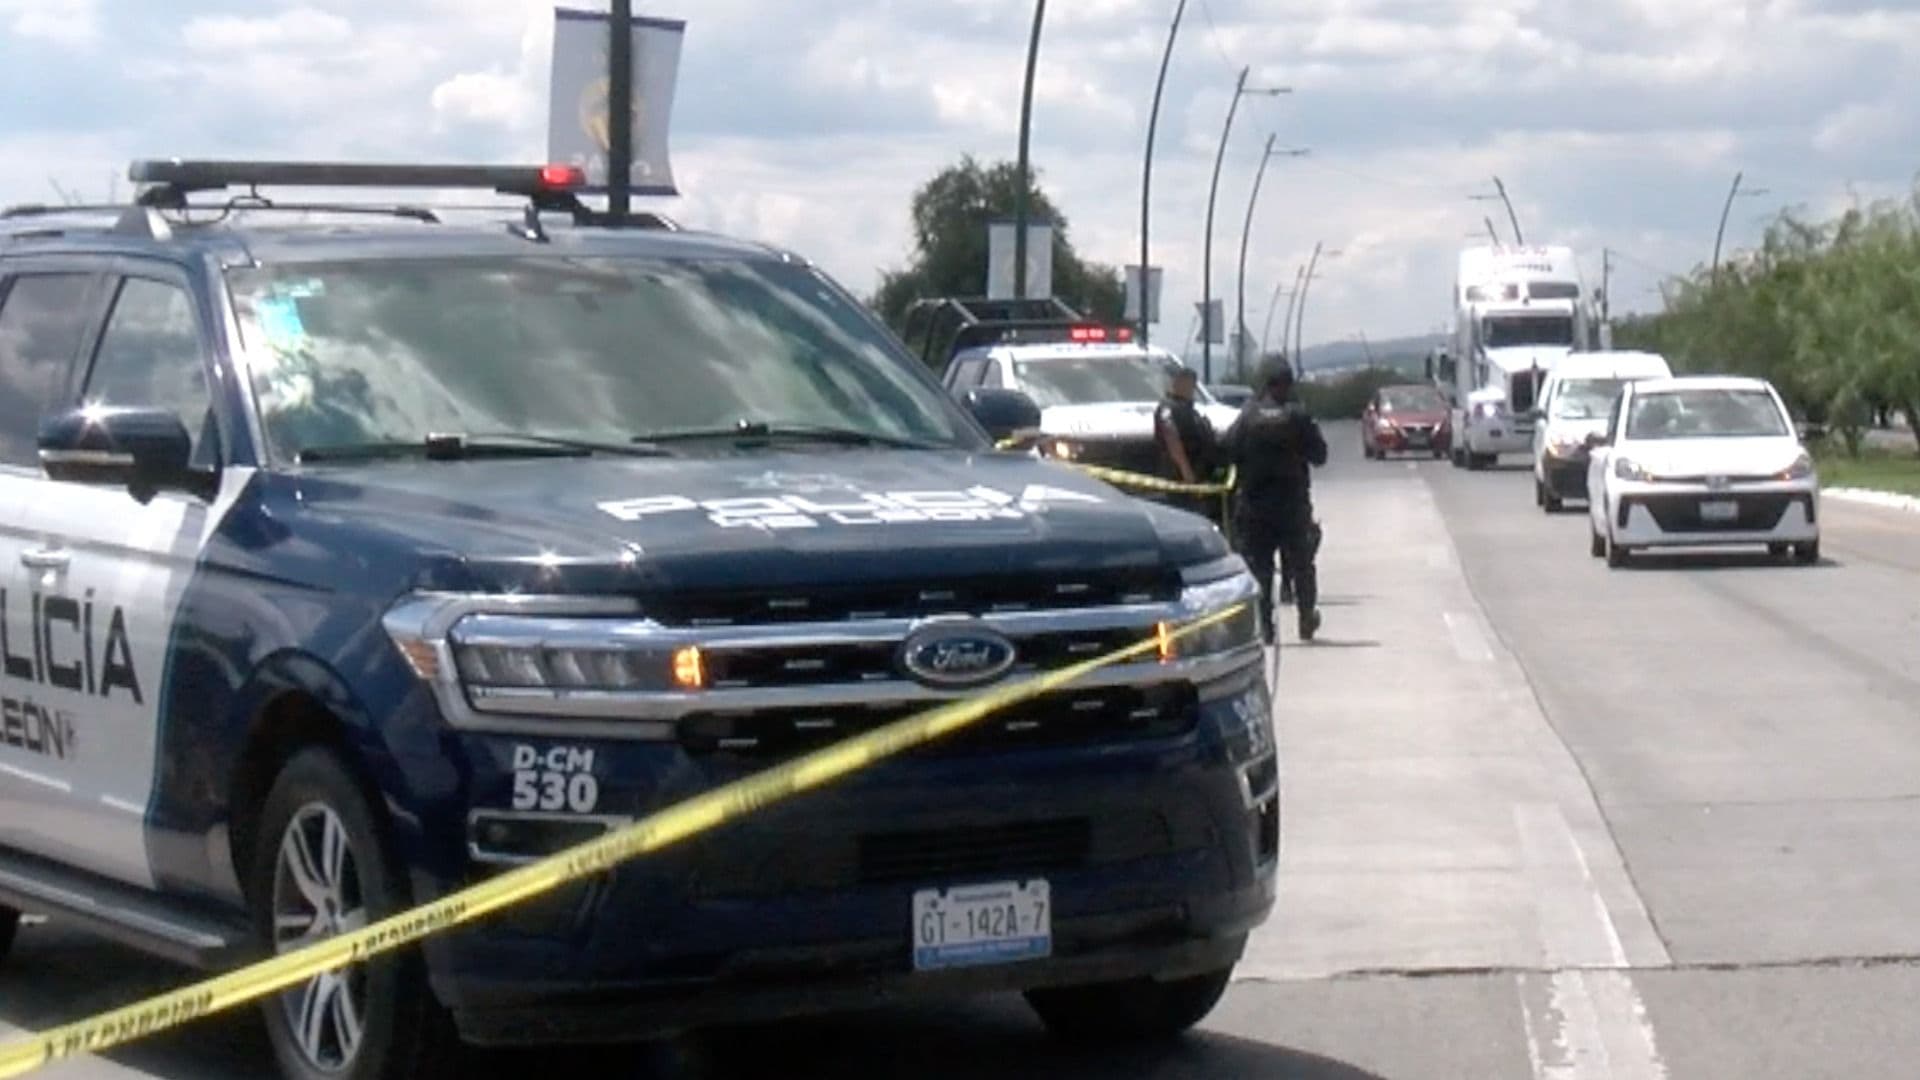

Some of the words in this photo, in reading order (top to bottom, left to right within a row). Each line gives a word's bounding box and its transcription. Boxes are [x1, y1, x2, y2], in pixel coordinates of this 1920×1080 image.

[513, 745, 595, 773] D-CM
[513, 770, 598, 814] 530
[920, 901, 1045, 945] GT-142A-7
